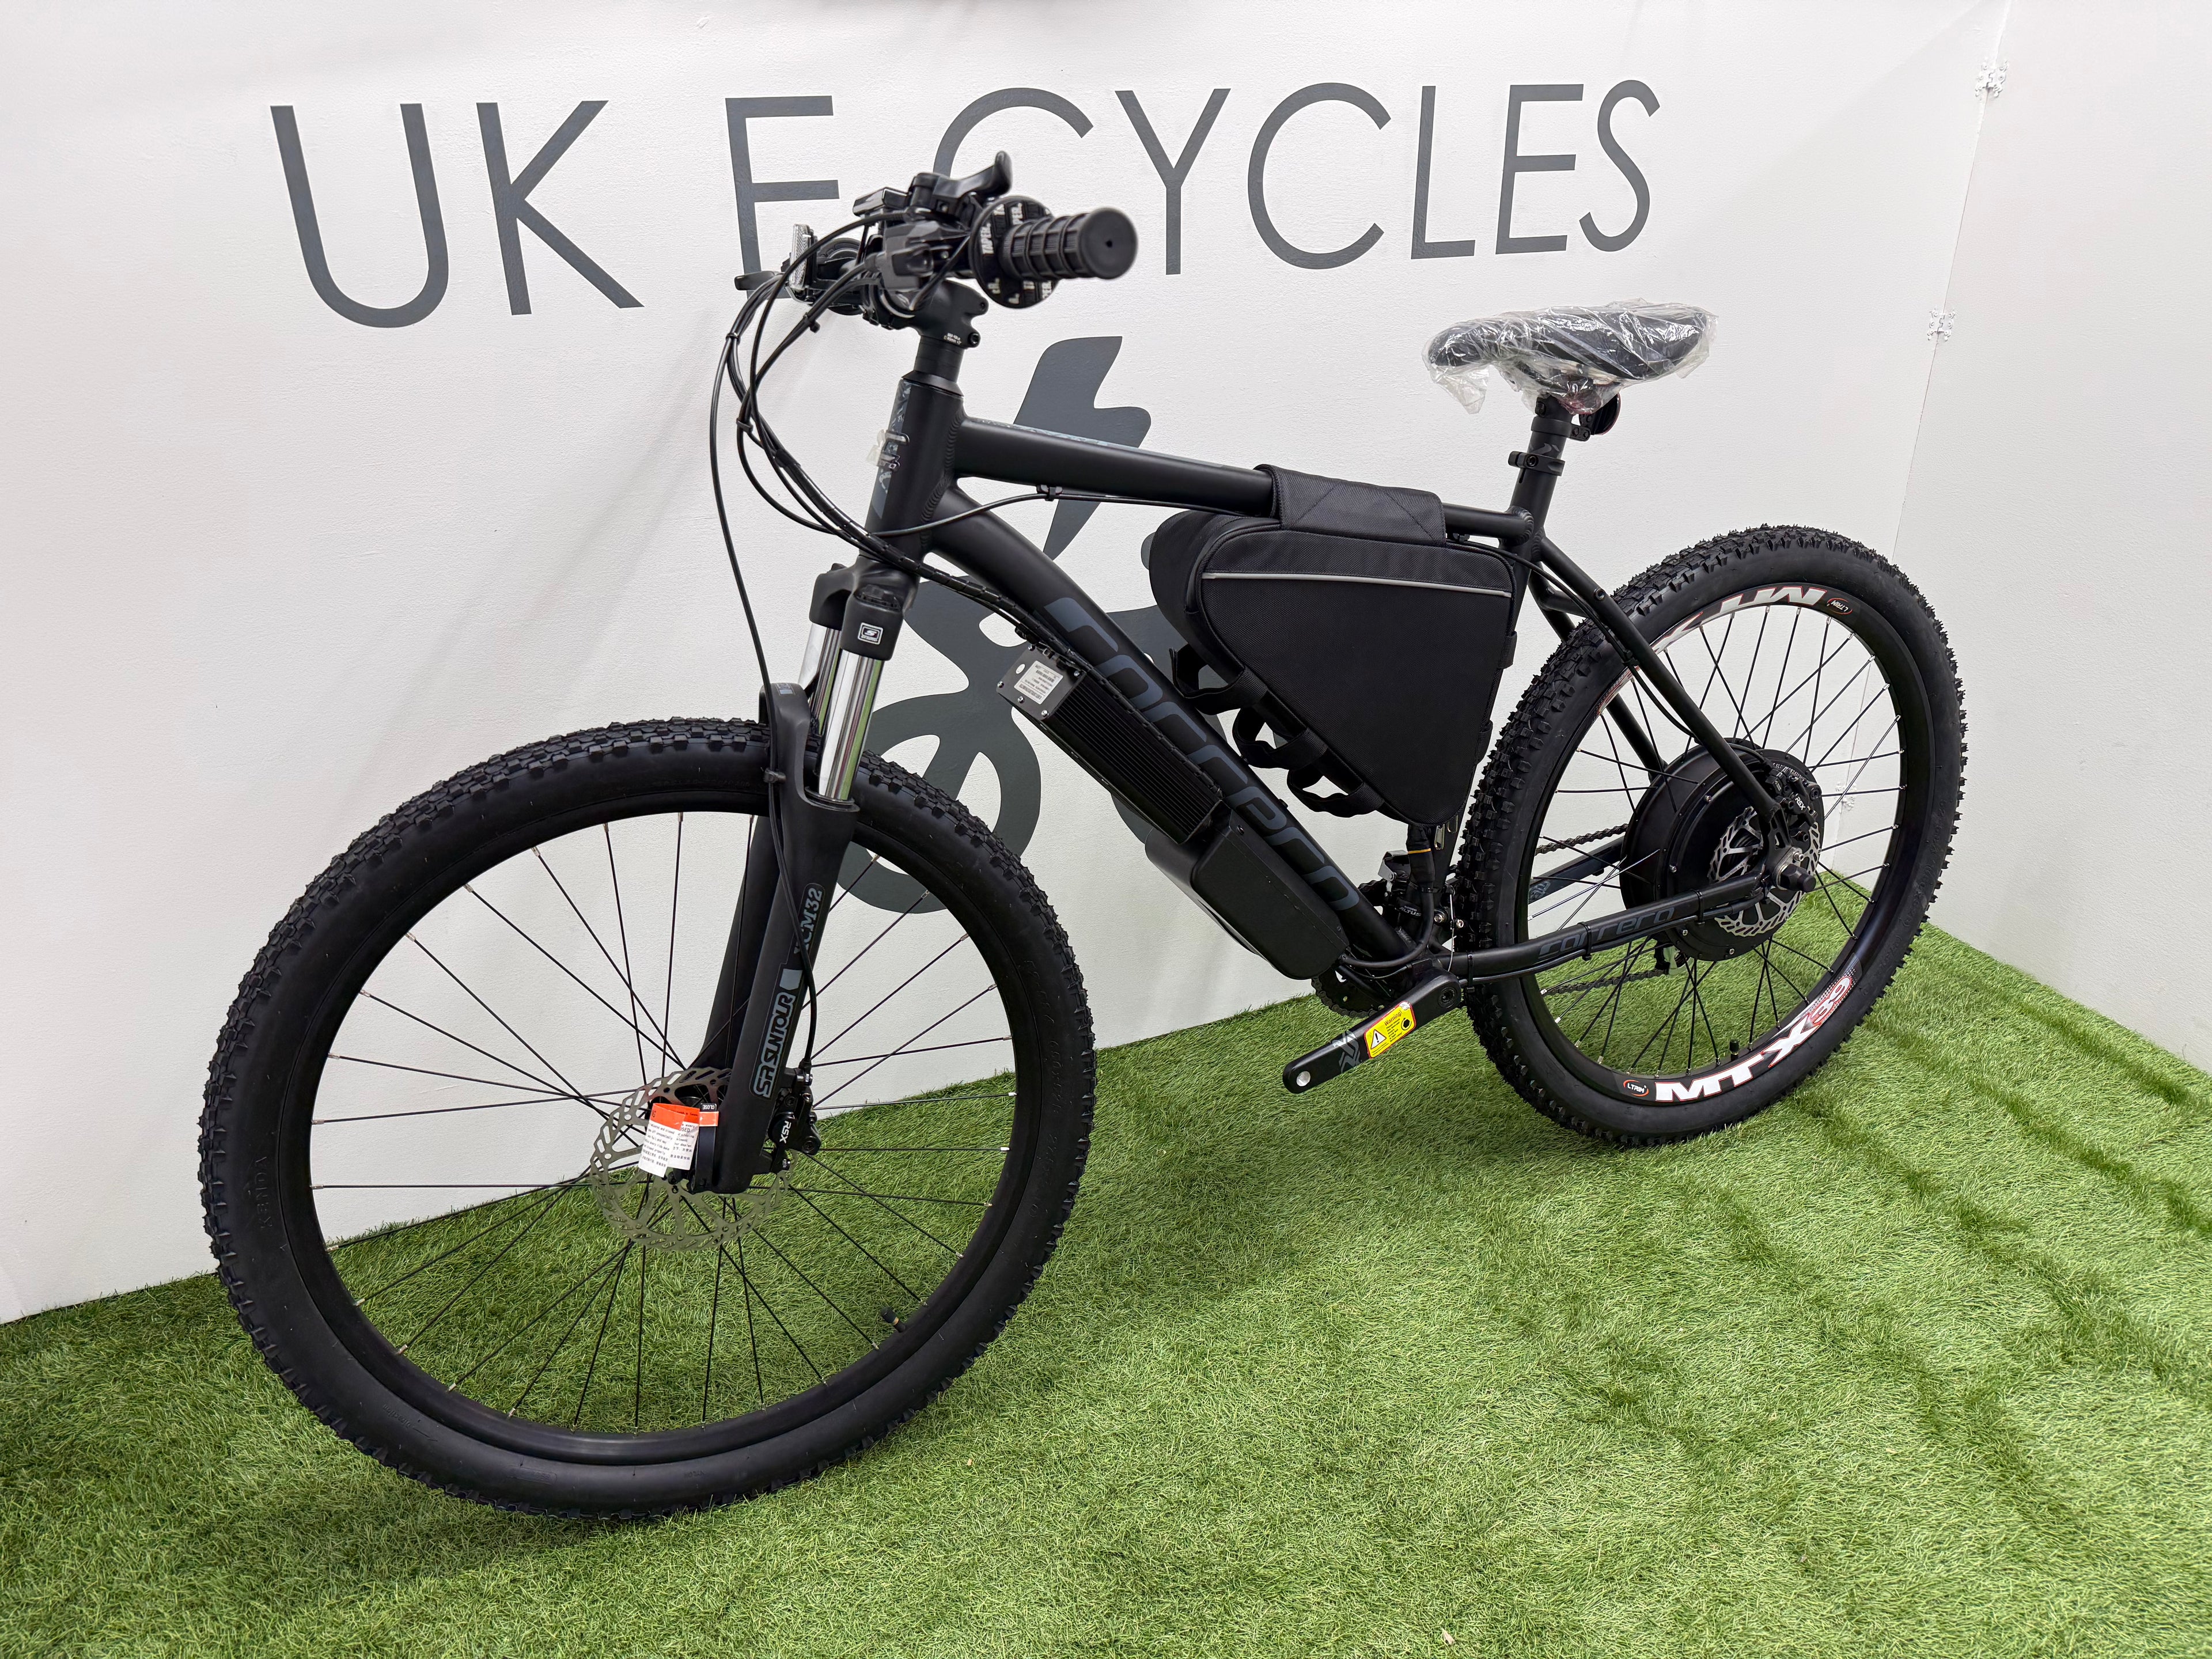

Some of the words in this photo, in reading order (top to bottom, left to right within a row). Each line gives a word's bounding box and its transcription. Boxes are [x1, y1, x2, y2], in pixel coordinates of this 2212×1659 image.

[270, 100, 645, 328] UK
[1794, 797, 1806, 810] RSX
[1399, 907, 1421, 916] ALTUS
[1627, 1082, 1646, 1094] LTRIM
[779, 1120, 791, 1144] RSX
